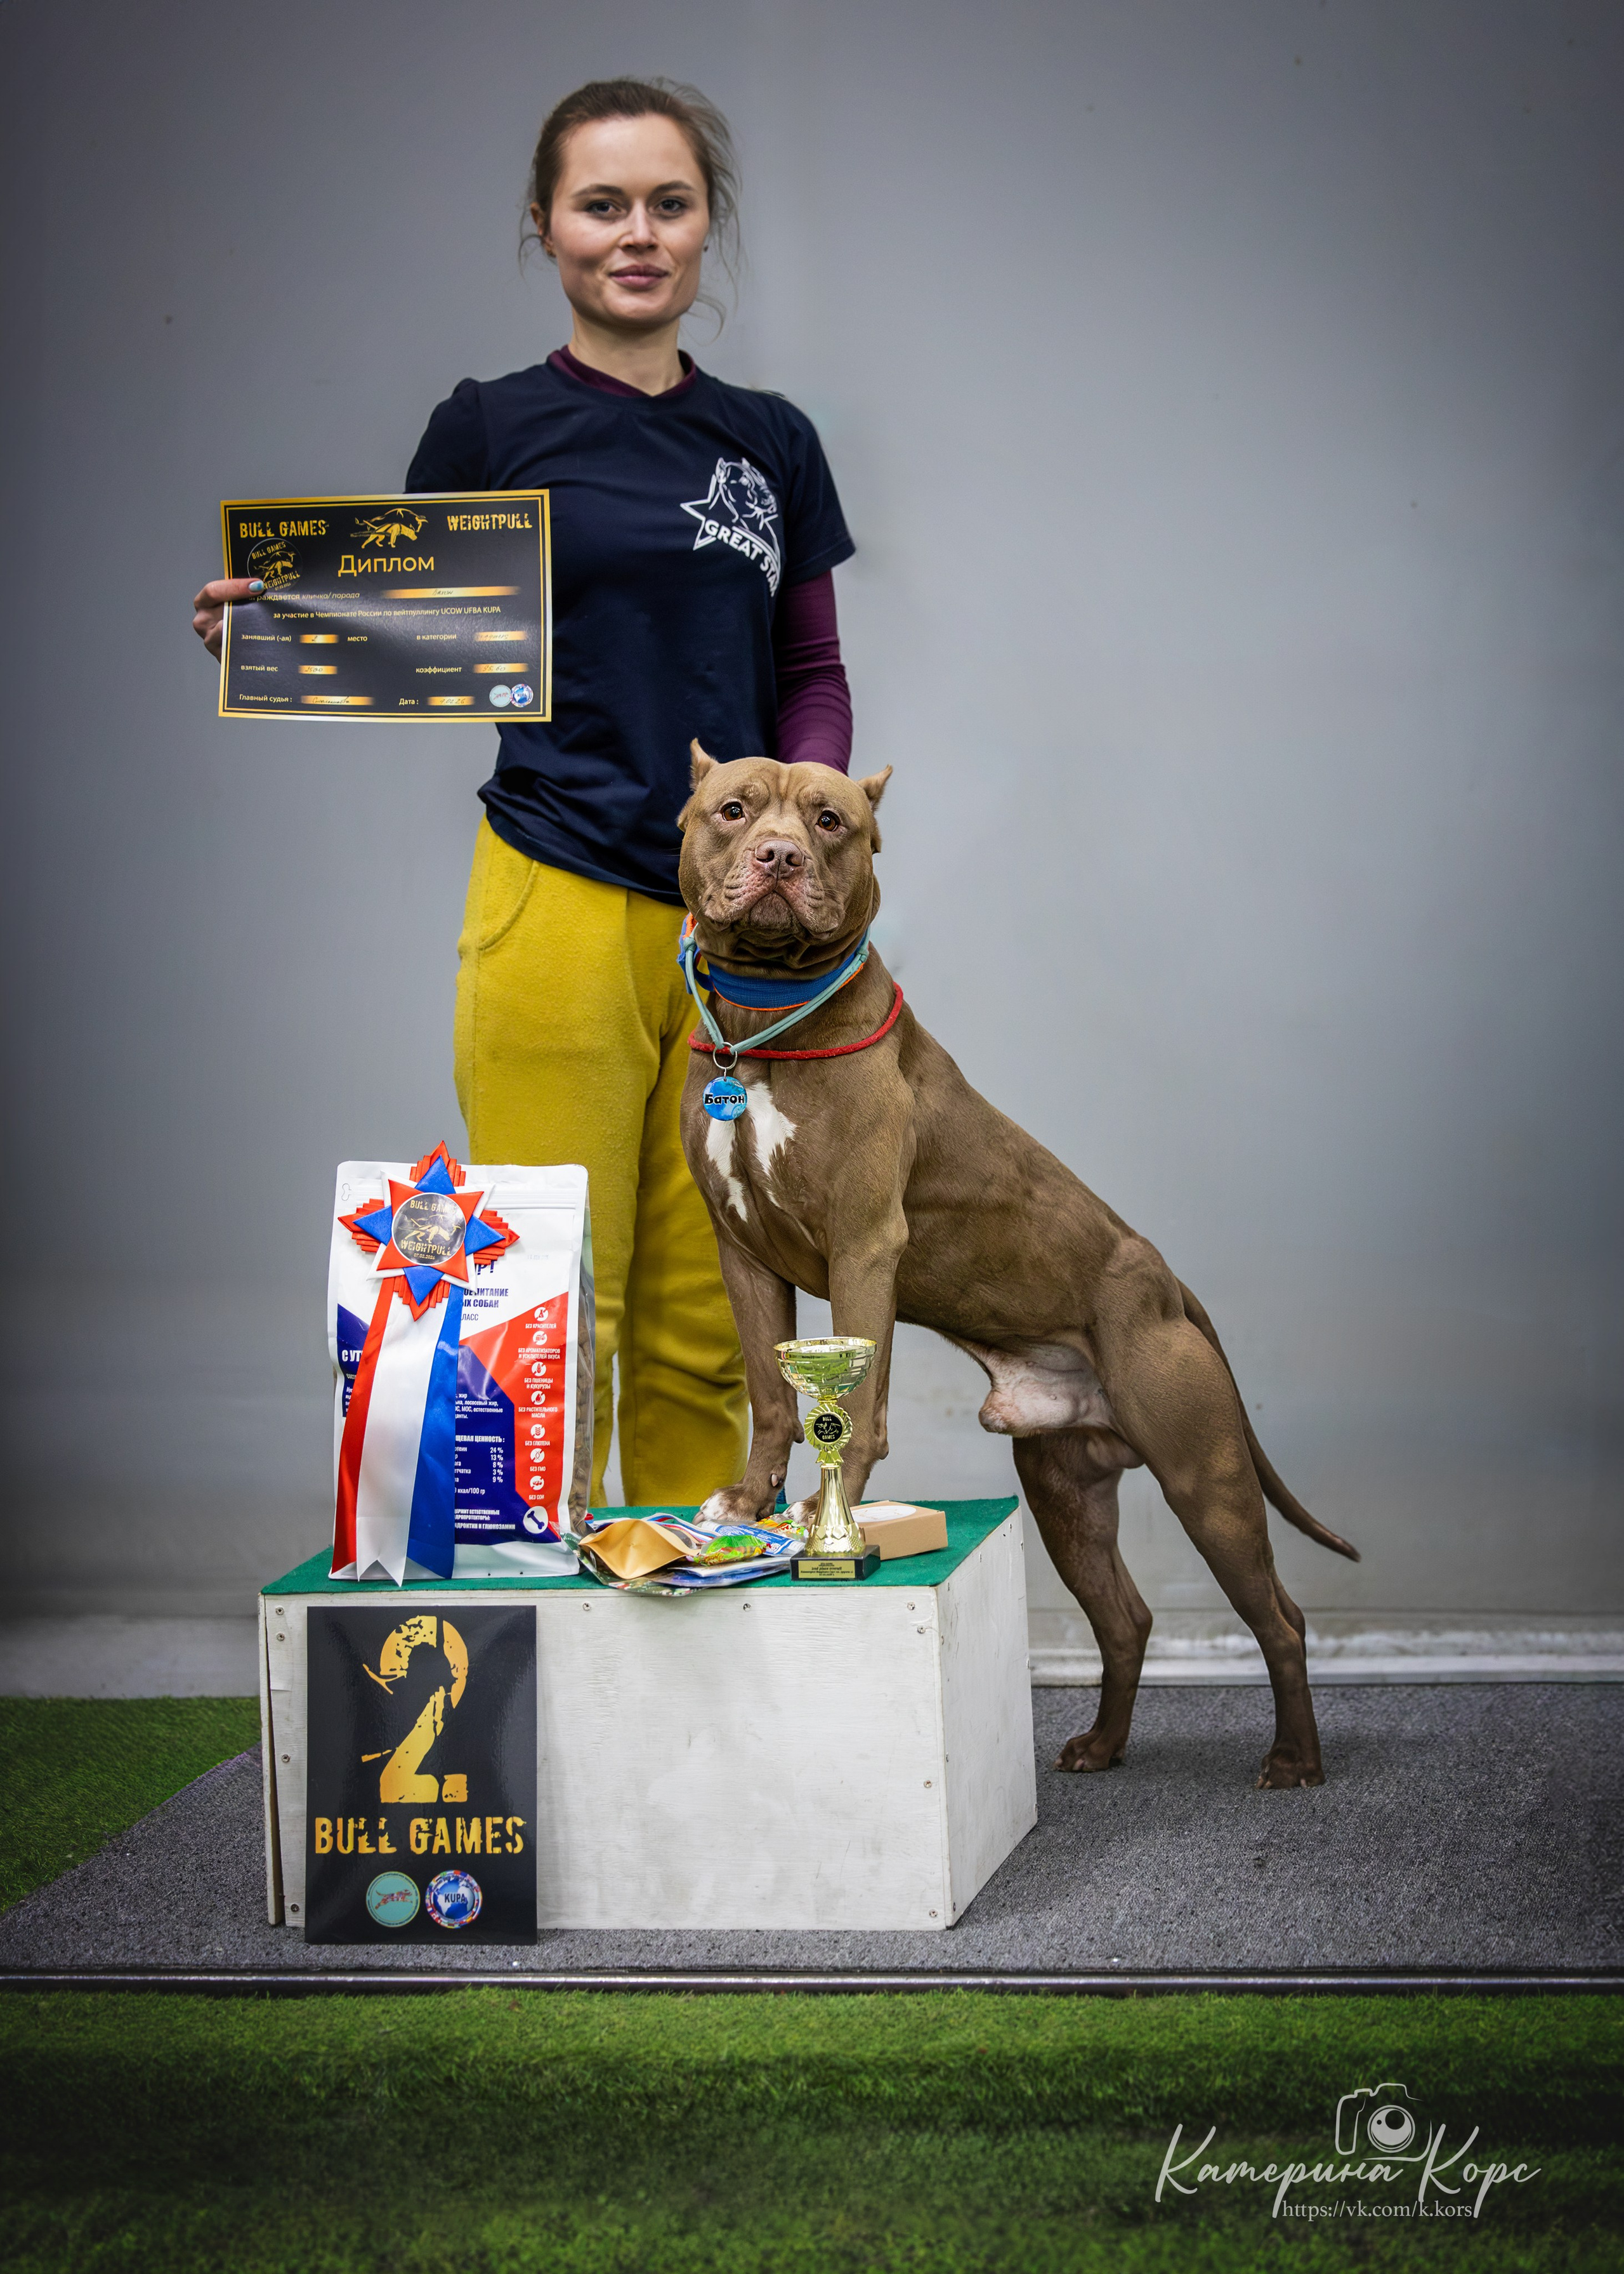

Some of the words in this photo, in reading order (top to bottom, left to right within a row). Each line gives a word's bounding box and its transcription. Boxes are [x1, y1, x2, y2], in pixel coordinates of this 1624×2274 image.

[240, 521, 274, 538] BULL
[279, 520, 329, 537] GAMES
[447, 513, 532, 531] WEIGHTPULL
[705, 519, 763, 560] GREAT
[251, 548, 266, 560] BULL
[266, 541, 286, 554] GAMES
[338, 555, 435, 577] Диплом
[332, 592, 360, 600] порода
[239, 693, 268, 702] Главный
[704, 1093, 745, 1104] Батон
[410, 1199, 429, 1211] BULL
[400, 1239, 452, 1256] WEIGHTPULL
[473, 1299, 499, 1308] СОБАК
[341, 1350, 348, 1362] С
[350, 1350, 363, 1362] УТ
[363, 1615, 469, 1803] 2
[315, 1817, 397, 1855] BULL
[409, 1816, 527, 1855] GAMES
[444, 1893, 466, 1903] KUPA
